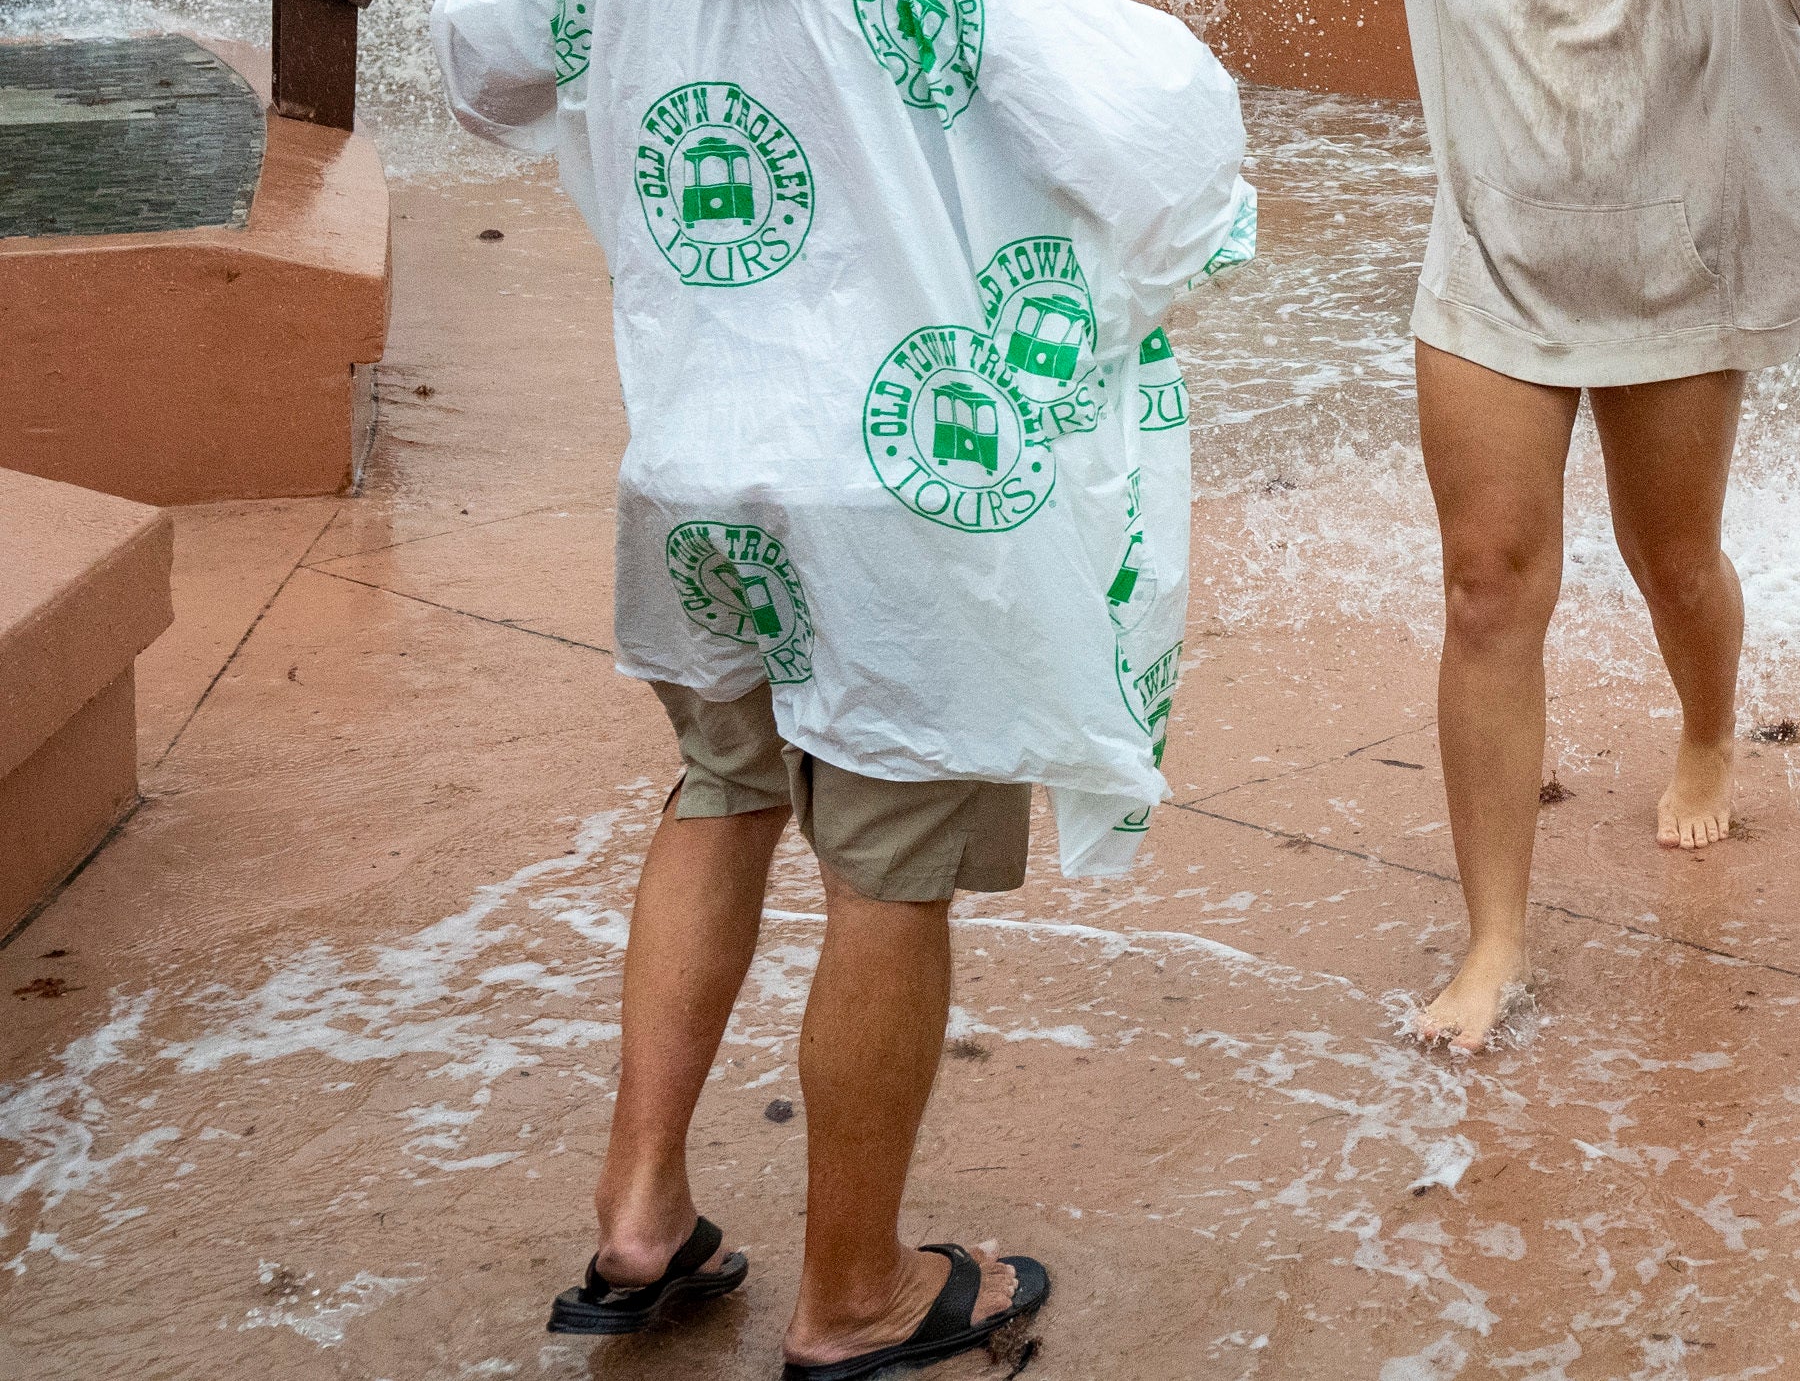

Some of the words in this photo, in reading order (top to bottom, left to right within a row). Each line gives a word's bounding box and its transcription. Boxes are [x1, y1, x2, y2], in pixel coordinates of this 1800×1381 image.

[646, 87, 709, 146] TOWN
[723, 87, 809, 209] TROLLEY
[638, 145, 669, 198] OLD
[665, 218, 790, 281] TOURS
[997, 242, 1080, 287] TOWN
[870, 381, 912, 437] OLD
[893, 331, 956, 381] TOWN
[893, 456, 1036, 527] TOURS
